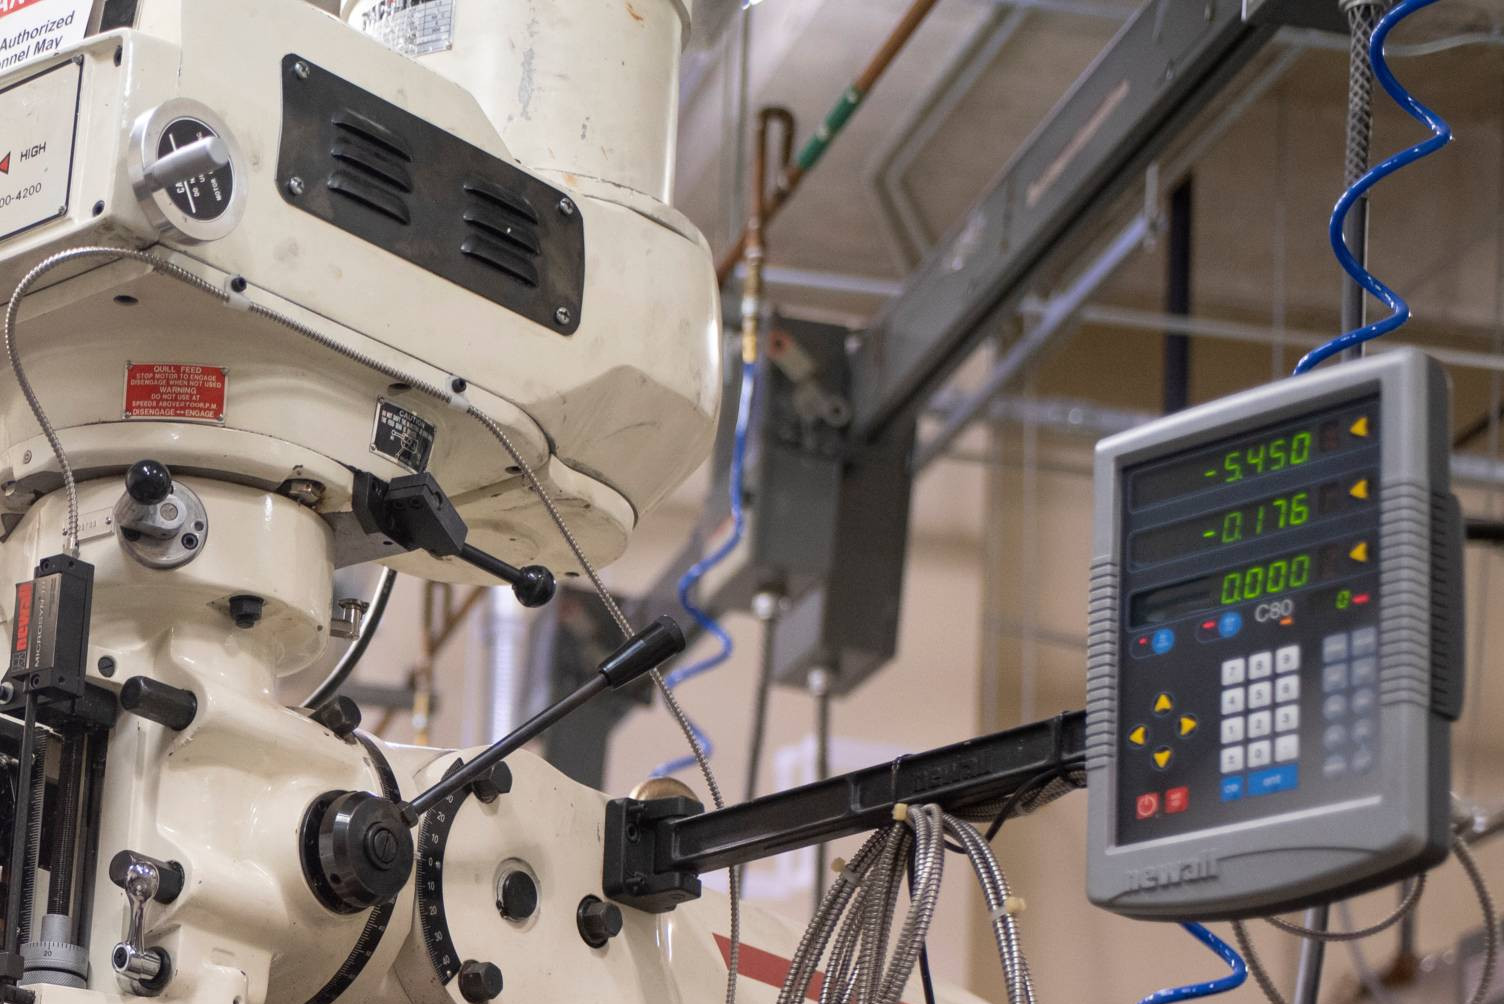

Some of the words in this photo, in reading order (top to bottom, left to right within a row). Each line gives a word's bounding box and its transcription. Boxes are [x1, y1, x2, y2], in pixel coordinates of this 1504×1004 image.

[33, 35, 64, 56] May
[19, 141, 47, 163] HIGH
[154, 365, 176, 373] QUILL
[181, 365, 202, 374] FEED
[160, 386, 197, 394] WARNING
[132, 408, 175, 416] DISENGAGE
[185, 409, 215, 417] ENGAGE
[399, 410, 425, 429] CAUTION
[1255, 599, 1293, 622] C80
[436, 811, 445, 823] 20
[428, 857, 433, 866] 0
[427, 881, 435, 891] 10
[429, 905, 437, 915] 20
